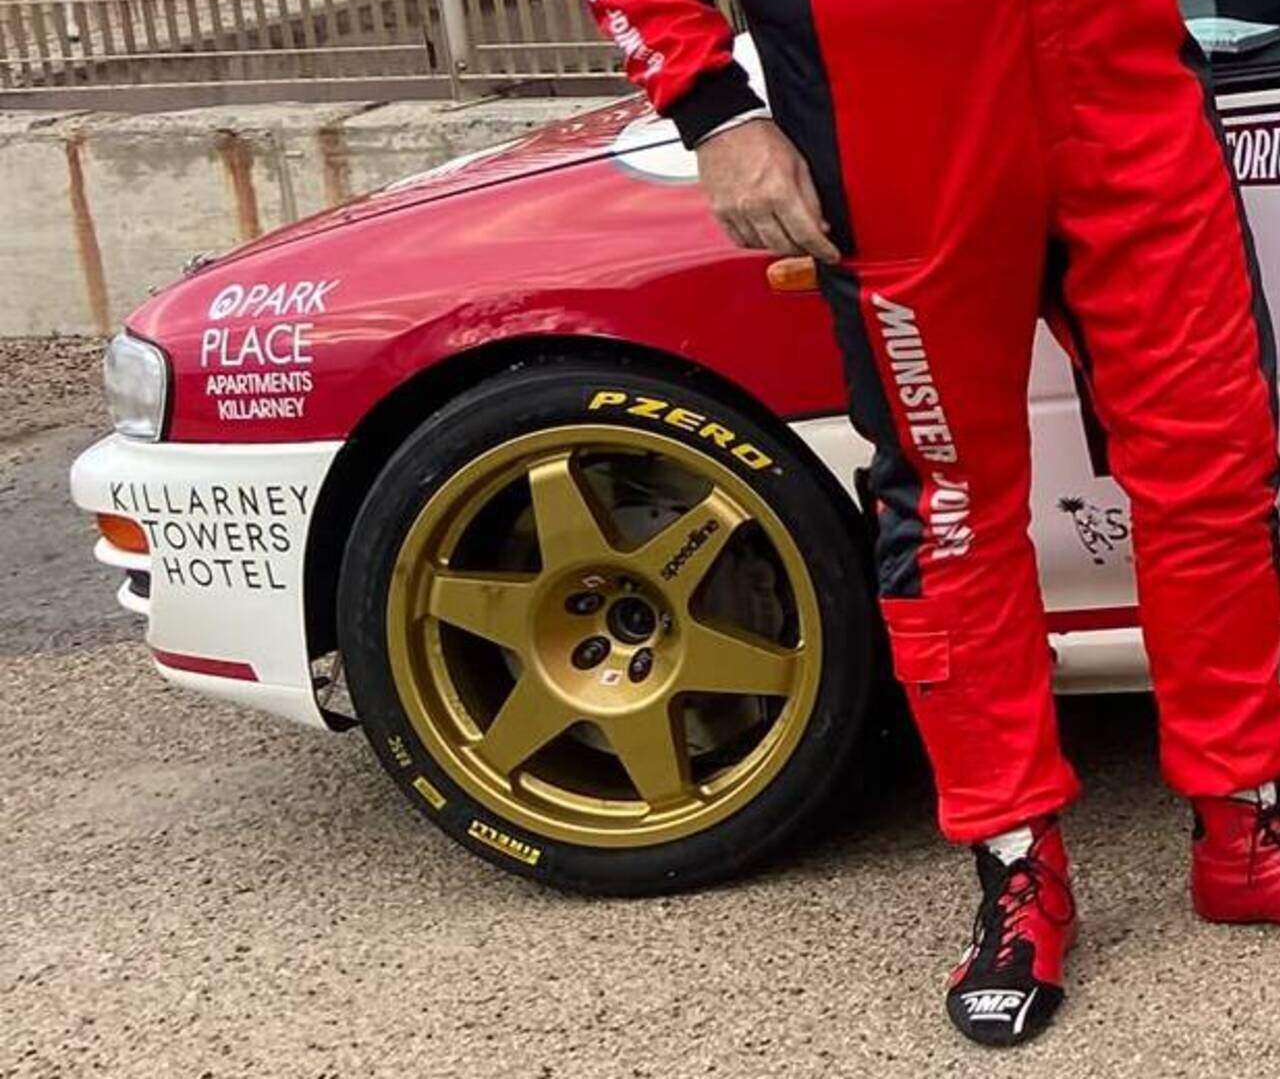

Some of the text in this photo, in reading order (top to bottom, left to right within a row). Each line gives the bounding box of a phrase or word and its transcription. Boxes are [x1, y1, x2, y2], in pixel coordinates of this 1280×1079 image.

[236, 280, 342, 318] PARK
[200, 323, 314, 367] PLACE
[206, 371, 314, 396] APARTMENTS
[871, 291, 959, 464] MUNSTER
[217, 397, 306, 420] KILLARNEY
[109, 482, 309, 516] KILLARNEY
[141, 519, 291, 553] TOWERS
[162, 556, 287, 590] HOTEL
[466, 819, 542, 867] PIRELLI
